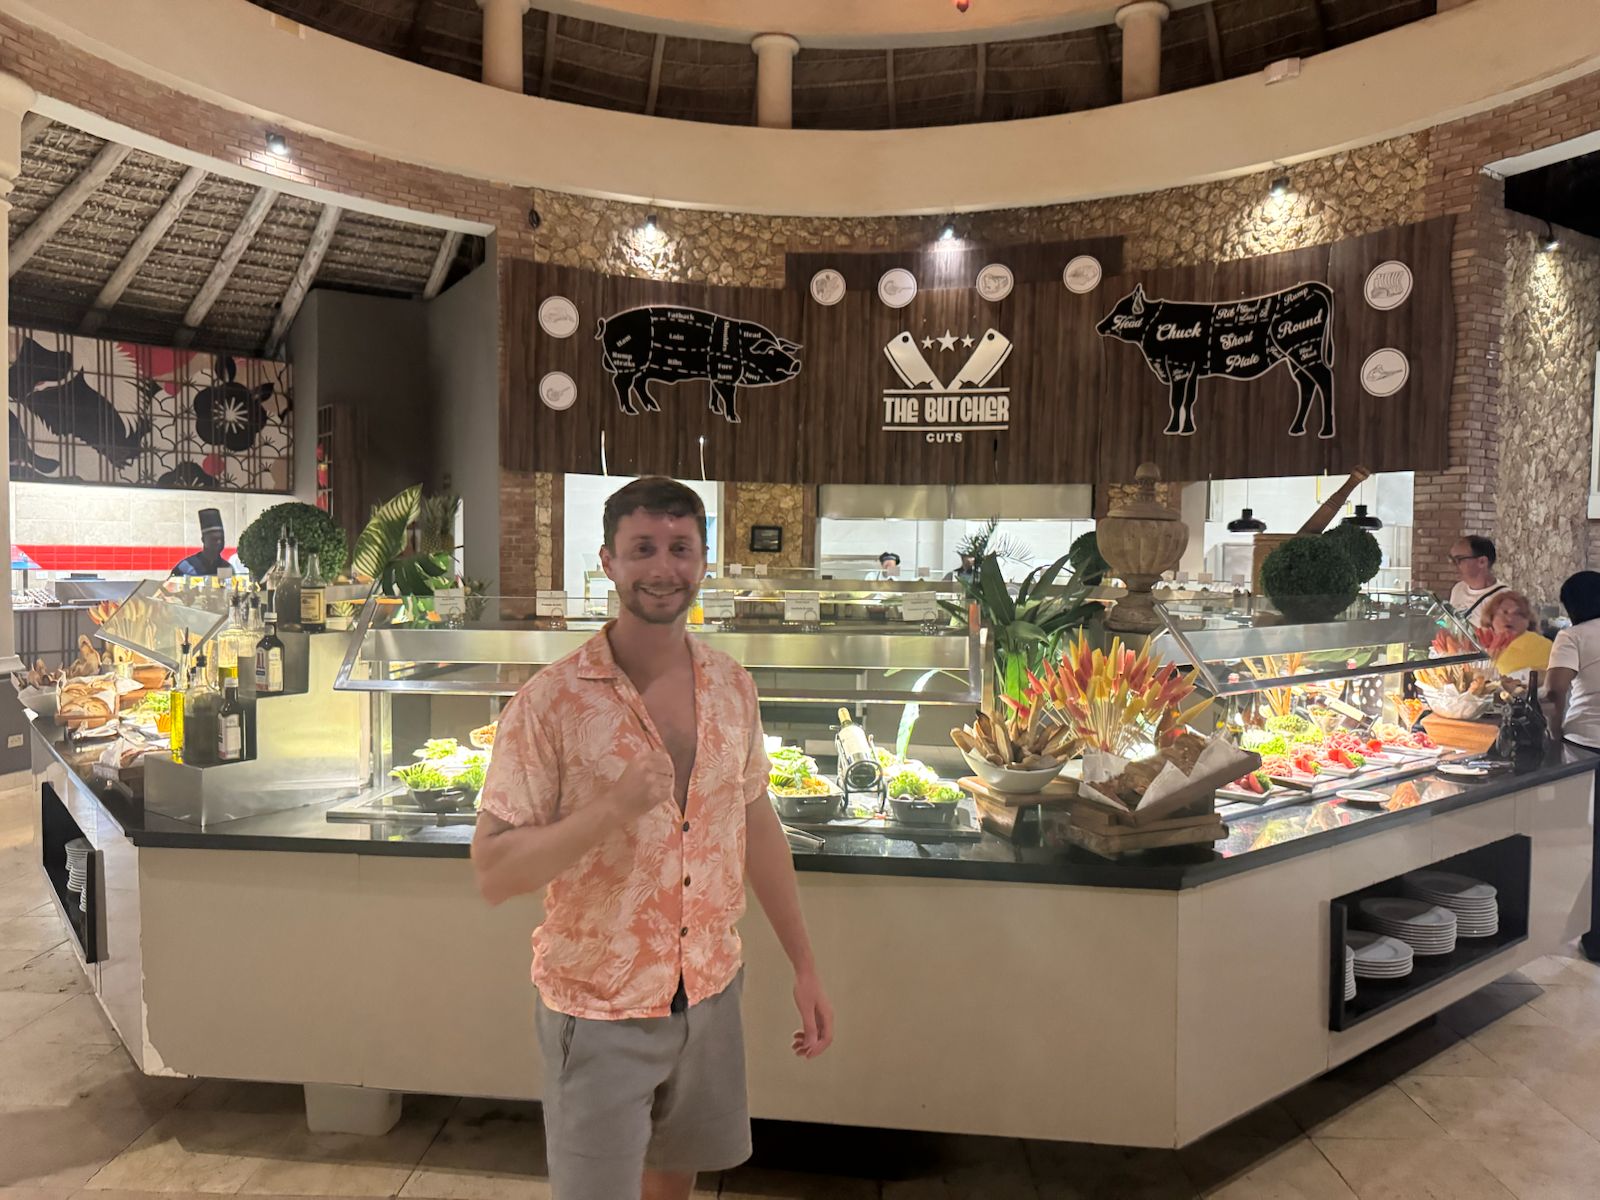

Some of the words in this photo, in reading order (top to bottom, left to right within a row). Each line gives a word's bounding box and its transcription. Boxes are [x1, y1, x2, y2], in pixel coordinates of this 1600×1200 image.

[1111, 314, 1144, 330] Head
[1215, 307, 1236, 320] Rib
[1156, 321, 1202, 341] Chuck
[1277, 309, 1322, 339] Round
[616, 334, 632, 348] Ham
[743, 331, 762, 339] Head
[1220, 331, 1253, 350] Short
[1226, 354, 1259, 372] Plate
[883, 397, 919, 424] THE
[925, 396, 1010, 422] BUTCHER
[926, 432, 963, 444] CUTS
